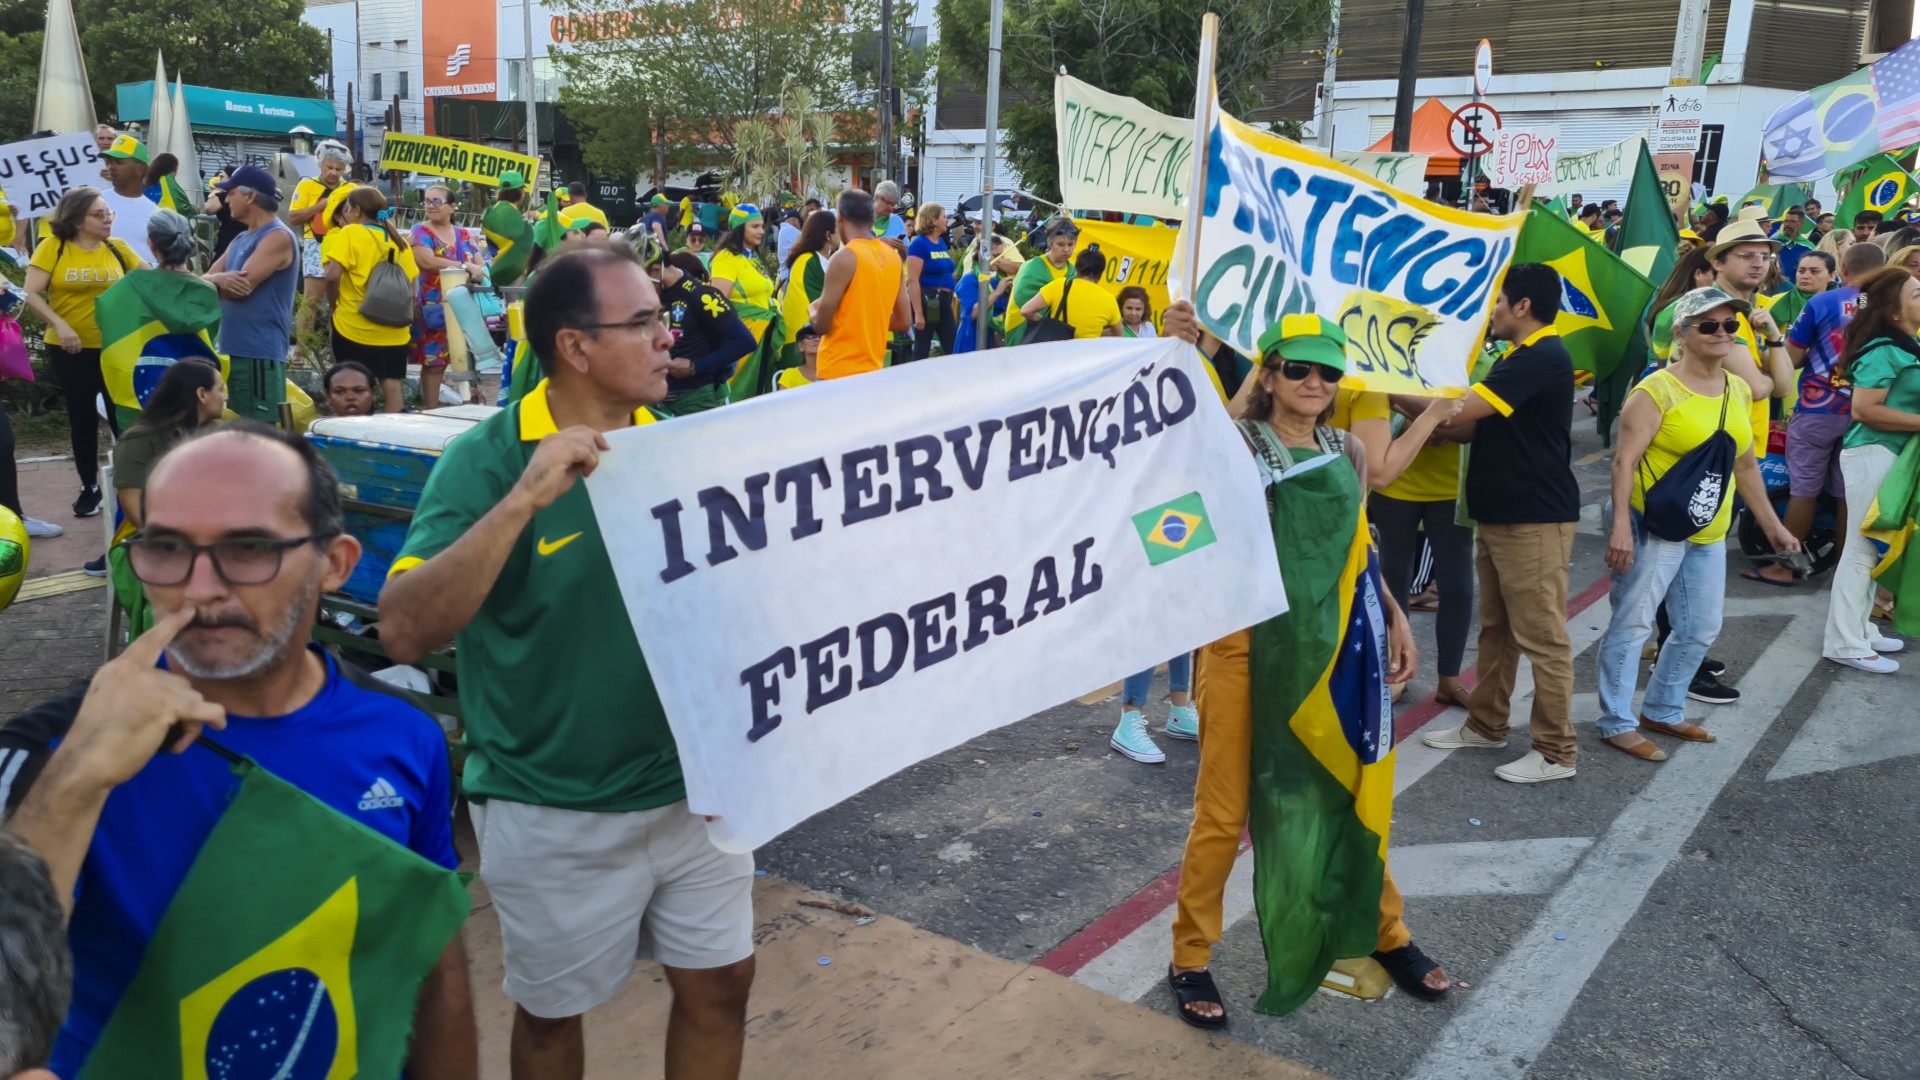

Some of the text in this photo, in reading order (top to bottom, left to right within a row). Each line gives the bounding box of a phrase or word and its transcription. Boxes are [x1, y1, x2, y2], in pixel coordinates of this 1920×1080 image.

[424, 82, 496, 96] CATEDRAL TECIDOS
[225, 100, 253, 113] Banca
[0, 144, 98, 179] JESUS
[382, 139, 468, 173] NTERVENÇÃO
[1497, 133, 1509, 185] CARTÃO
[35, 167, 69, 188] TE
[600, 186, 618, 196] 100
[30, 186, 74, 212] AM
[650, 362, 1196, 584] INTERVENÇÃO
[740, 537, 1103, 743] FEDERAL
[1378, 633, 1391, 747] PRORESSO
[358, 797, 404, 810] adidas
